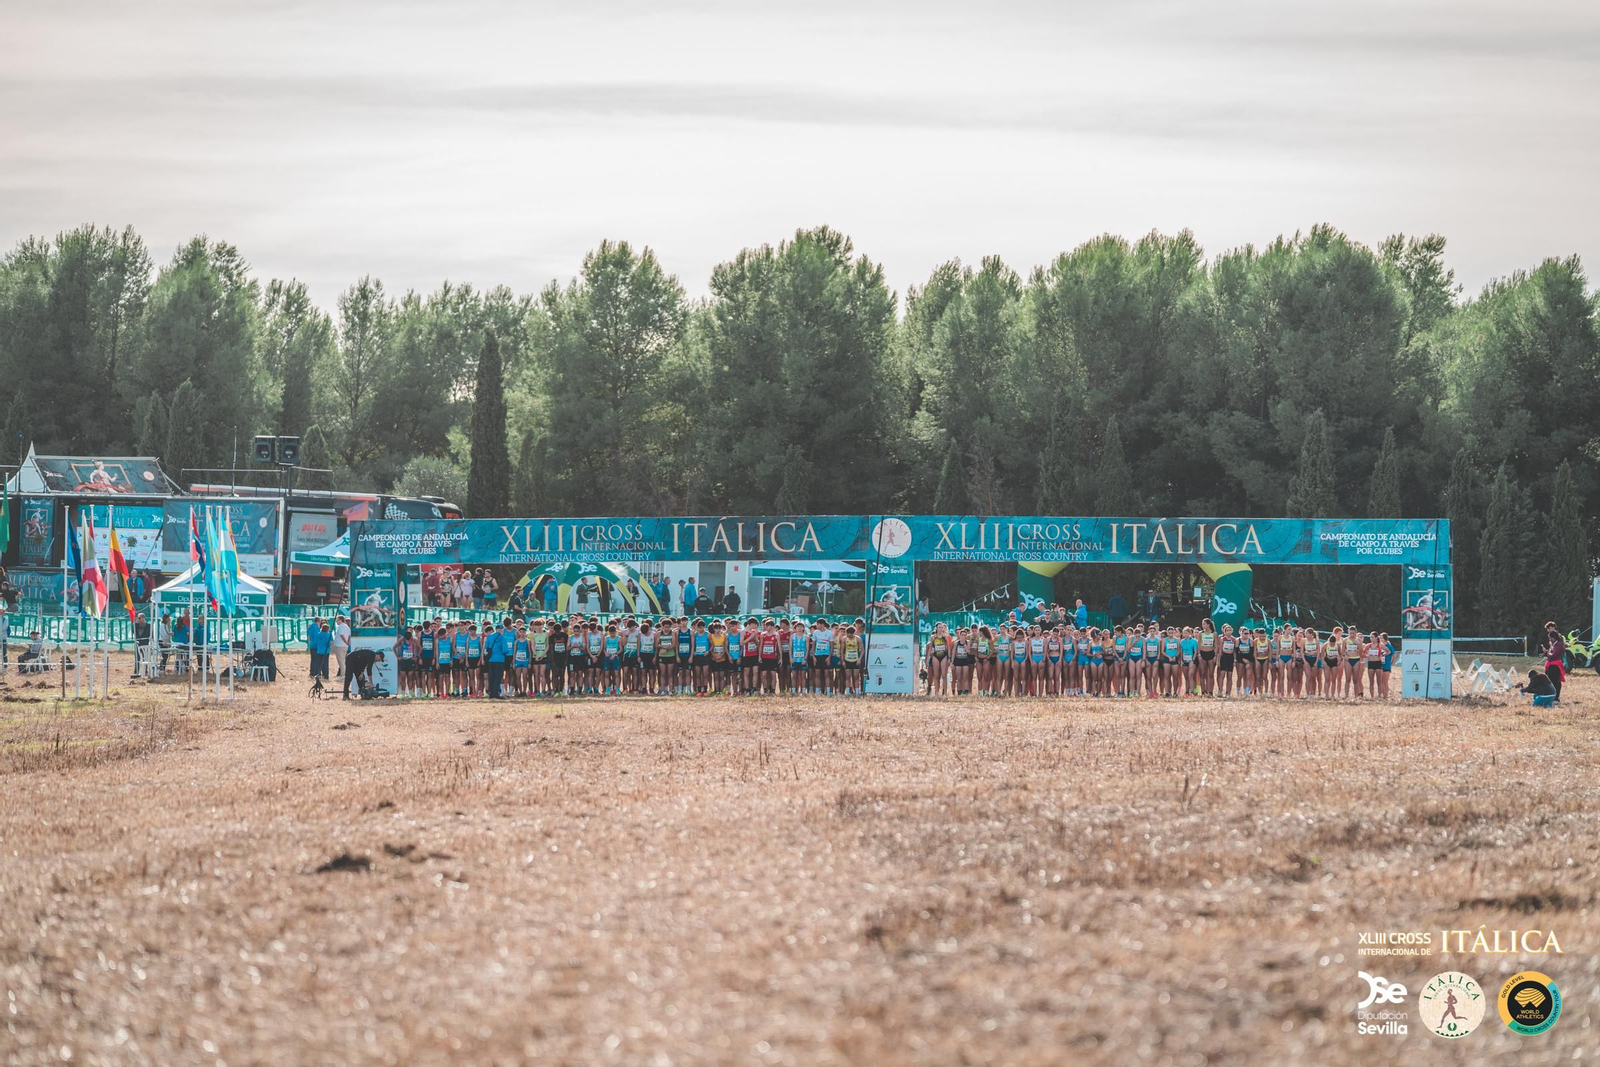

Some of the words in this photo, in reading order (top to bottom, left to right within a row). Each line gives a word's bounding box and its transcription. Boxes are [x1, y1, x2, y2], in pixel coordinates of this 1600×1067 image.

[423, 532, 468, 540] ANDALUCÍA
[499, 525, 579, 552] XLIII
[581, 524, 643, 541] CROSS
[672, 517, 824, 553] ITÁLICA
[934, 523, 1015, 550] XLIII
[1017, 524, 1081, 540] CROSS
[1110, 517, 1266, 554] ITÁLICA
[1389, 532, 1437, 540] ANDALUCÍA
[581, 542, 665, 551] INTERNACIONAL
[1017, 541, 1104, 551] INTERNACIONAL
[499, 554, 574, 562] INTERNATIONAL
[576, 553, 605, 562] CROSS
[606, 552, 651, 561] COUNTRY
[934, 551, 1010, 560] INTERNATIONAL
[1012, 552, 1041, 560] CROSS
[1043, 552, 1088, 561] COUNTRY
